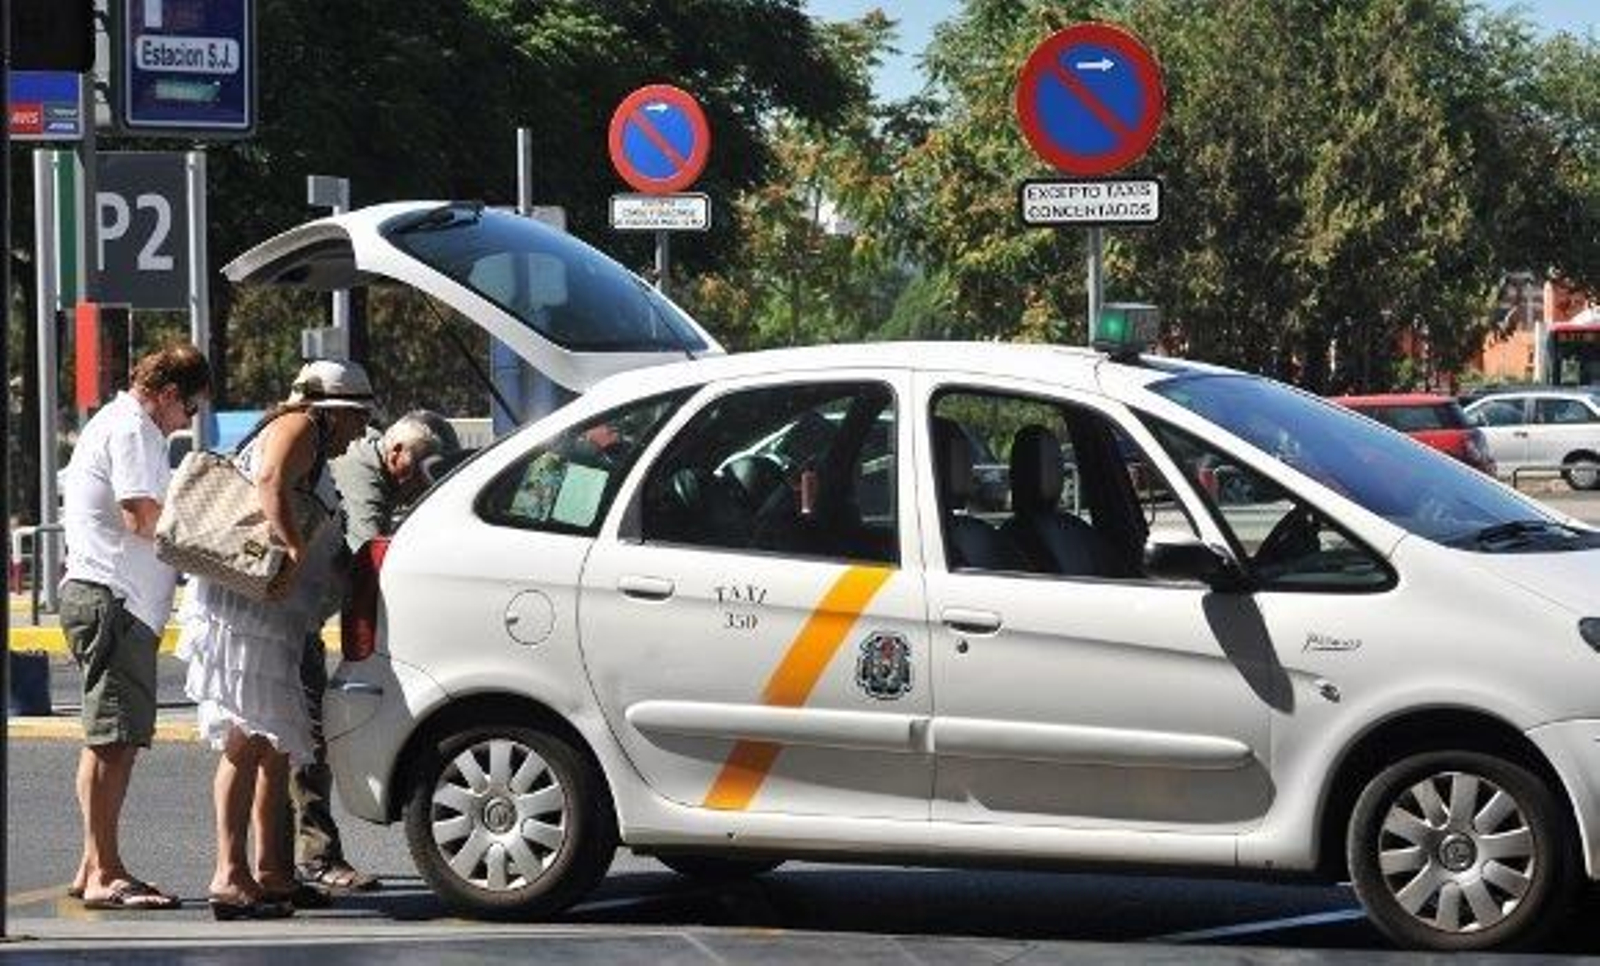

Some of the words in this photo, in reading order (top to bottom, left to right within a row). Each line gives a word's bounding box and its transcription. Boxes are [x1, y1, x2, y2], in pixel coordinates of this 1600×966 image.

[1027, 186, 1101, 199] EXCEPTO
[1106, 183, 1151, 198] TAXIS
[96, 192, 174, 270] P2
